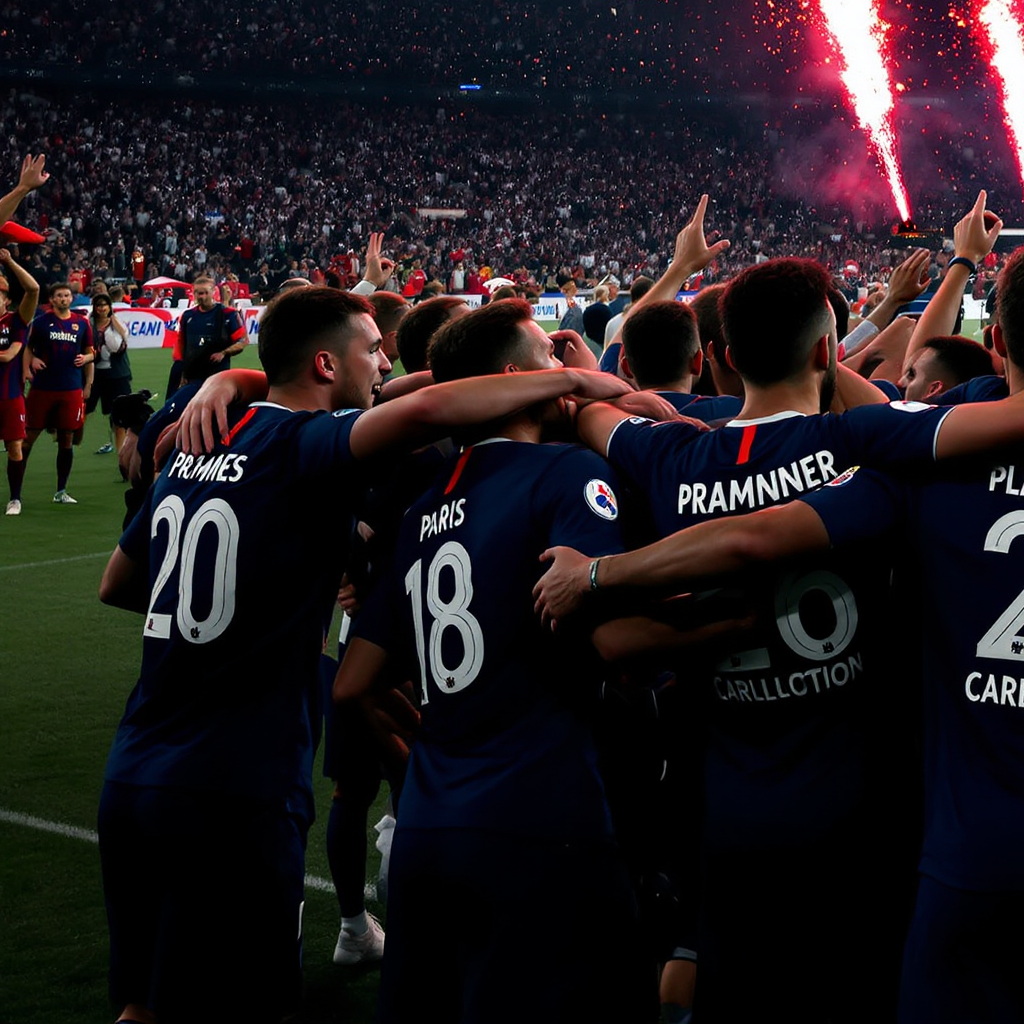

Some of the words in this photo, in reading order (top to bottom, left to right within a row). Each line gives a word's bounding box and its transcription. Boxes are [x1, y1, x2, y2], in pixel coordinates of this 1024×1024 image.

[420, 498, 466, 542] PARIS
[678, 450, 837, 514] PRAMNNER
[143, 494, 239, 644] 20
[405, 541, 485, 706] 18
